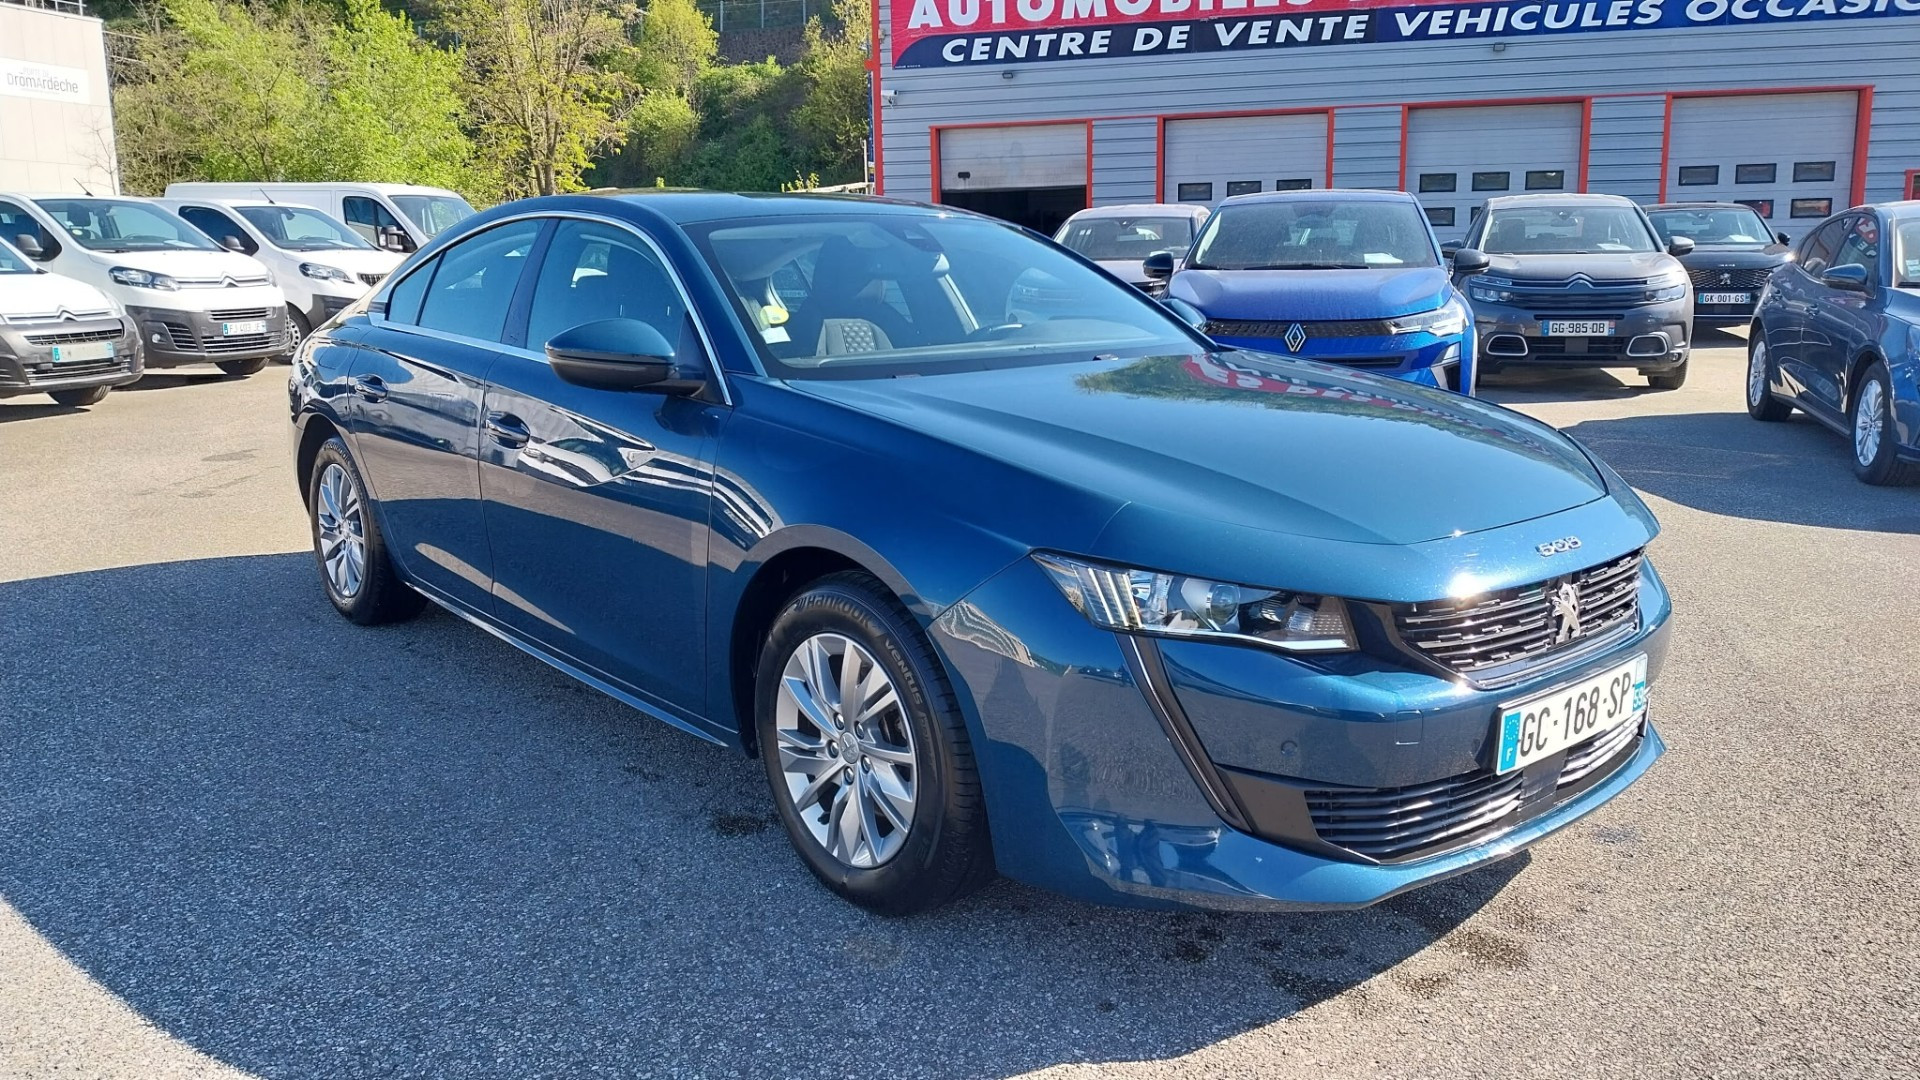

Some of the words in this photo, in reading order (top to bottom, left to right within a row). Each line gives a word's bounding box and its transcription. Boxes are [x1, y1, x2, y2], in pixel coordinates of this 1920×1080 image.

[907, 0, 1316, 29] AUTOMO
[942, 30, 1112, 62] CENTRE
[1132, 25, 1190, 51] DE
[1214, 14, 1369, 46] VENTE
[1395, 0, 1666, 36] VEHICULES
[1537, 536, 1582, 556] 508
[1520, 671, 1632, 758] GC-168-SP
[1505, 747, 1514, 762] F
